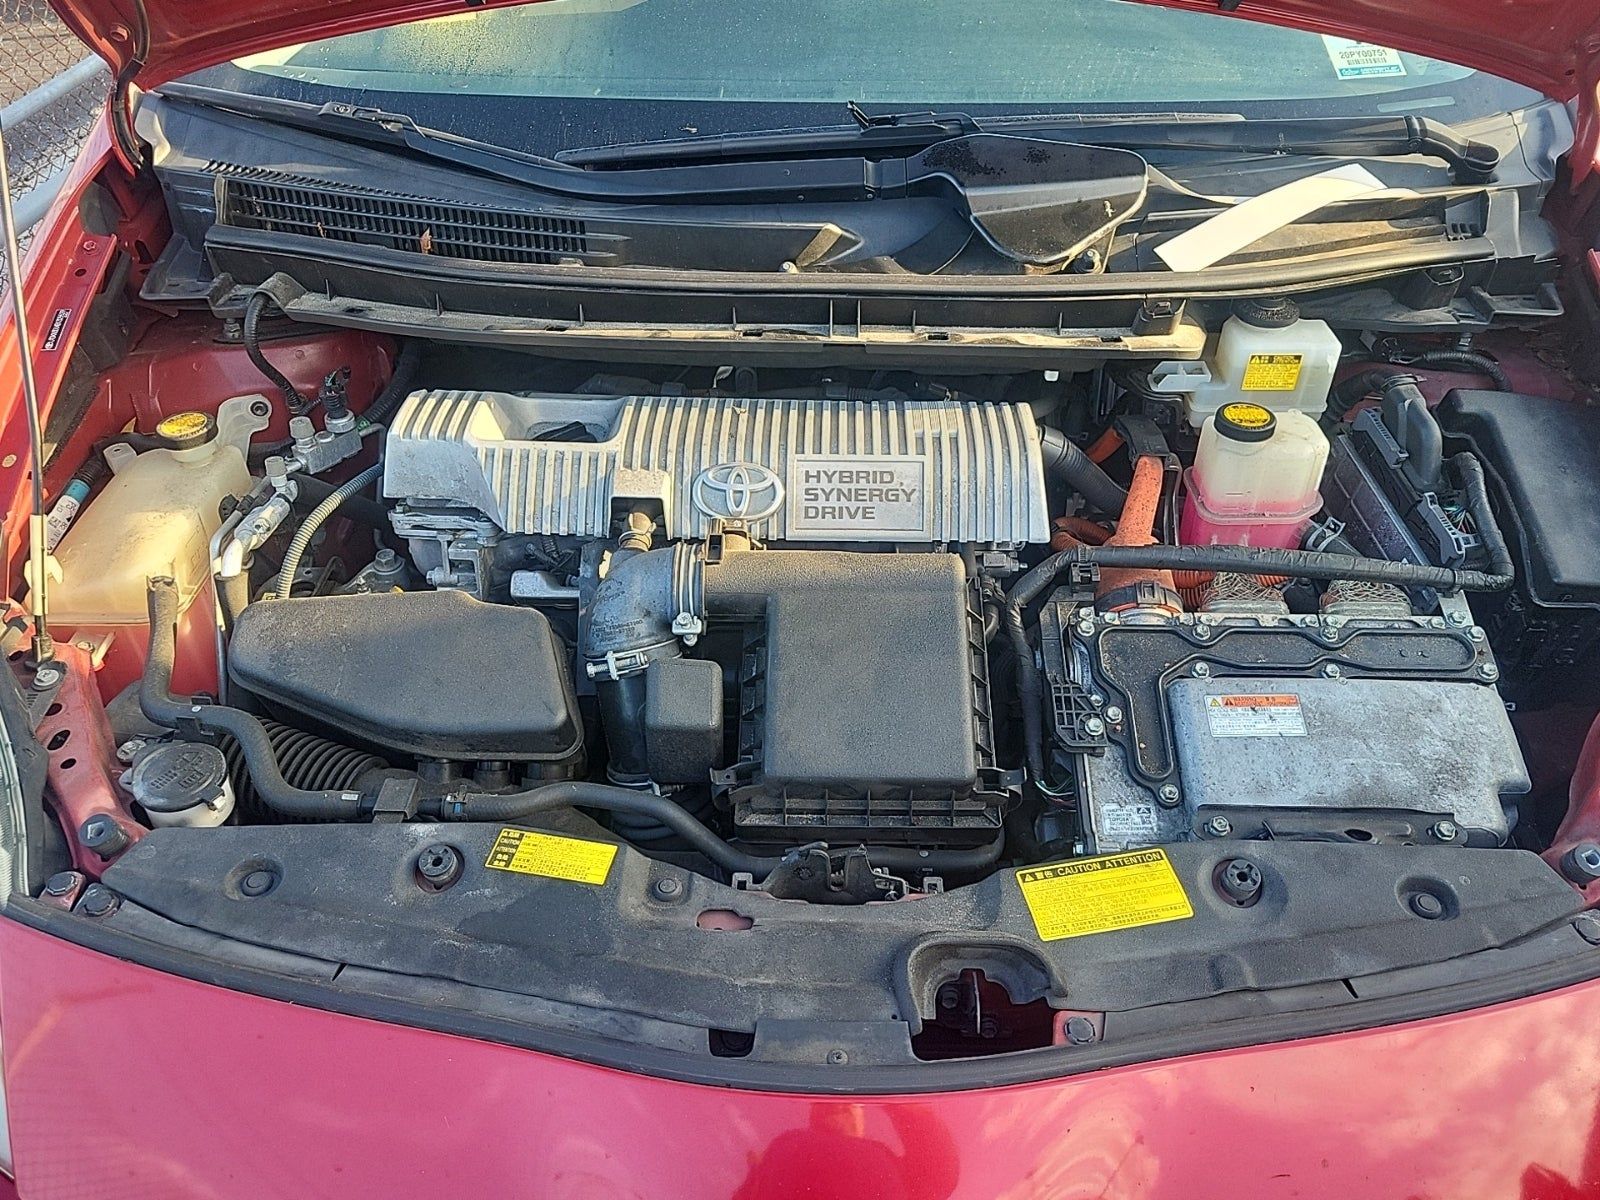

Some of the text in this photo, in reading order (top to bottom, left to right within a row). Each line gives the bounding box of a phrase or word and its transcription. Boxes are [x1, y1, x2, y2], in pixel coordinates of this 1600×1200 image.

[804, 470, 895, 484] HYBRID
[804, 488, 917, 502] SYNERGY
[803, 506, 876, 519] DRIVE
[1057, 863, 1101, 876] CAUTION
[1105, 852, 1161, 868] ATTENTION
